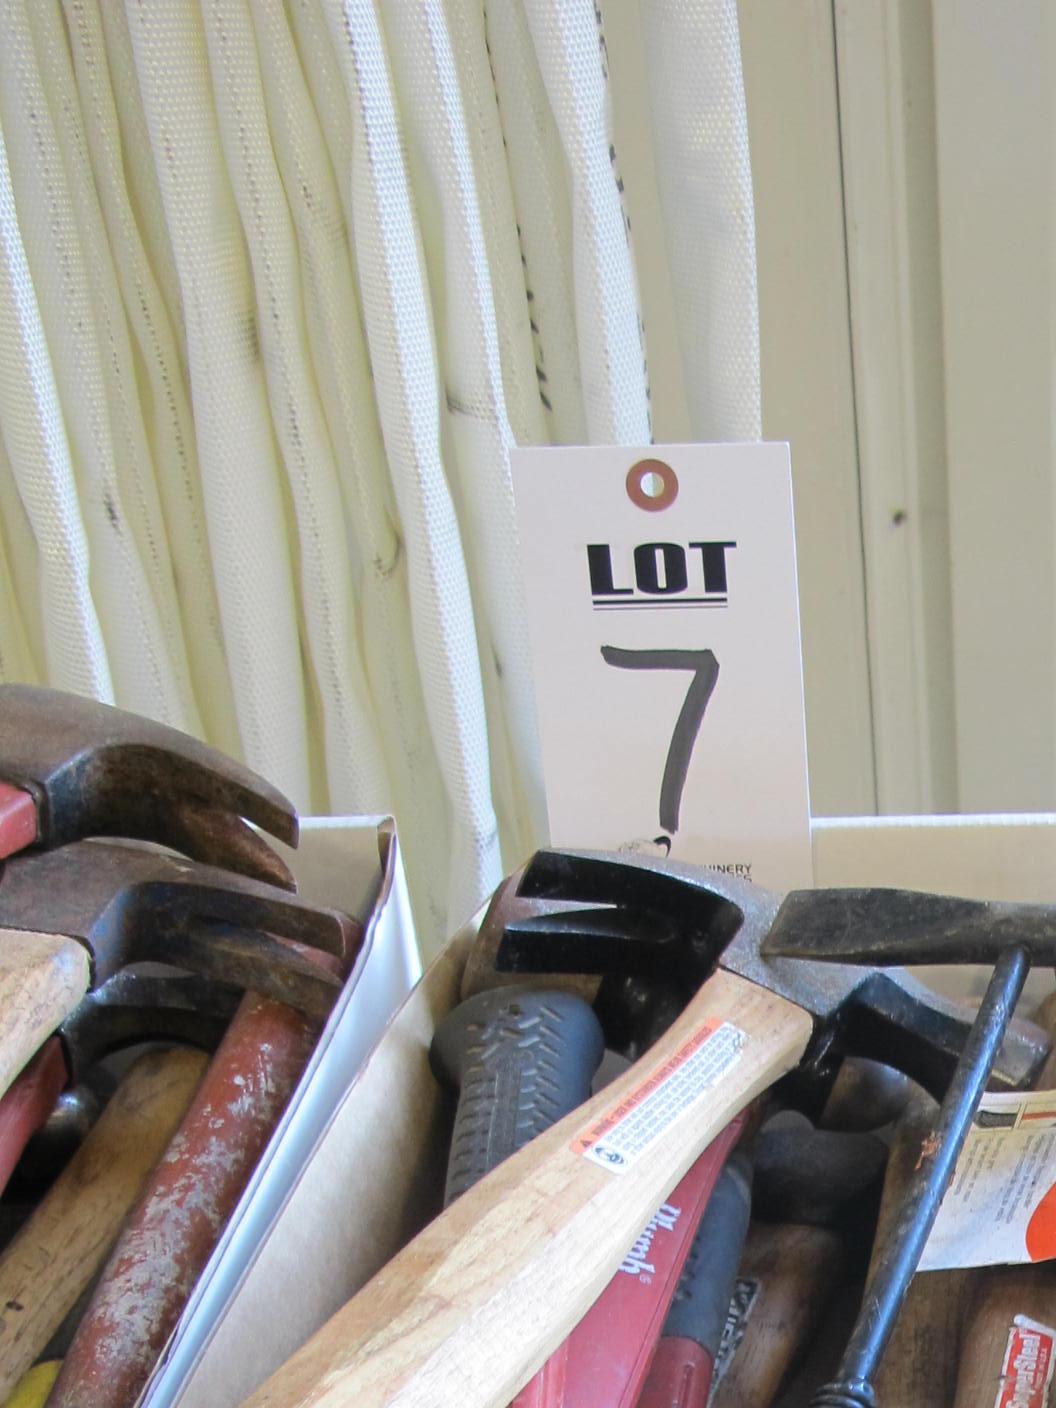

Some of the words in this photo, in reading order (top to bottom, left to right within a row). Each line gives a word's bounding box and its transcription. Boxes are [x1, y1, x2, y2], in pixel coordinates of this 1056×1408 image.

[586, 541, 737, 596] LOT
[600, 644, 720, 835] 7
[703, 863, 752, 875] INERY
